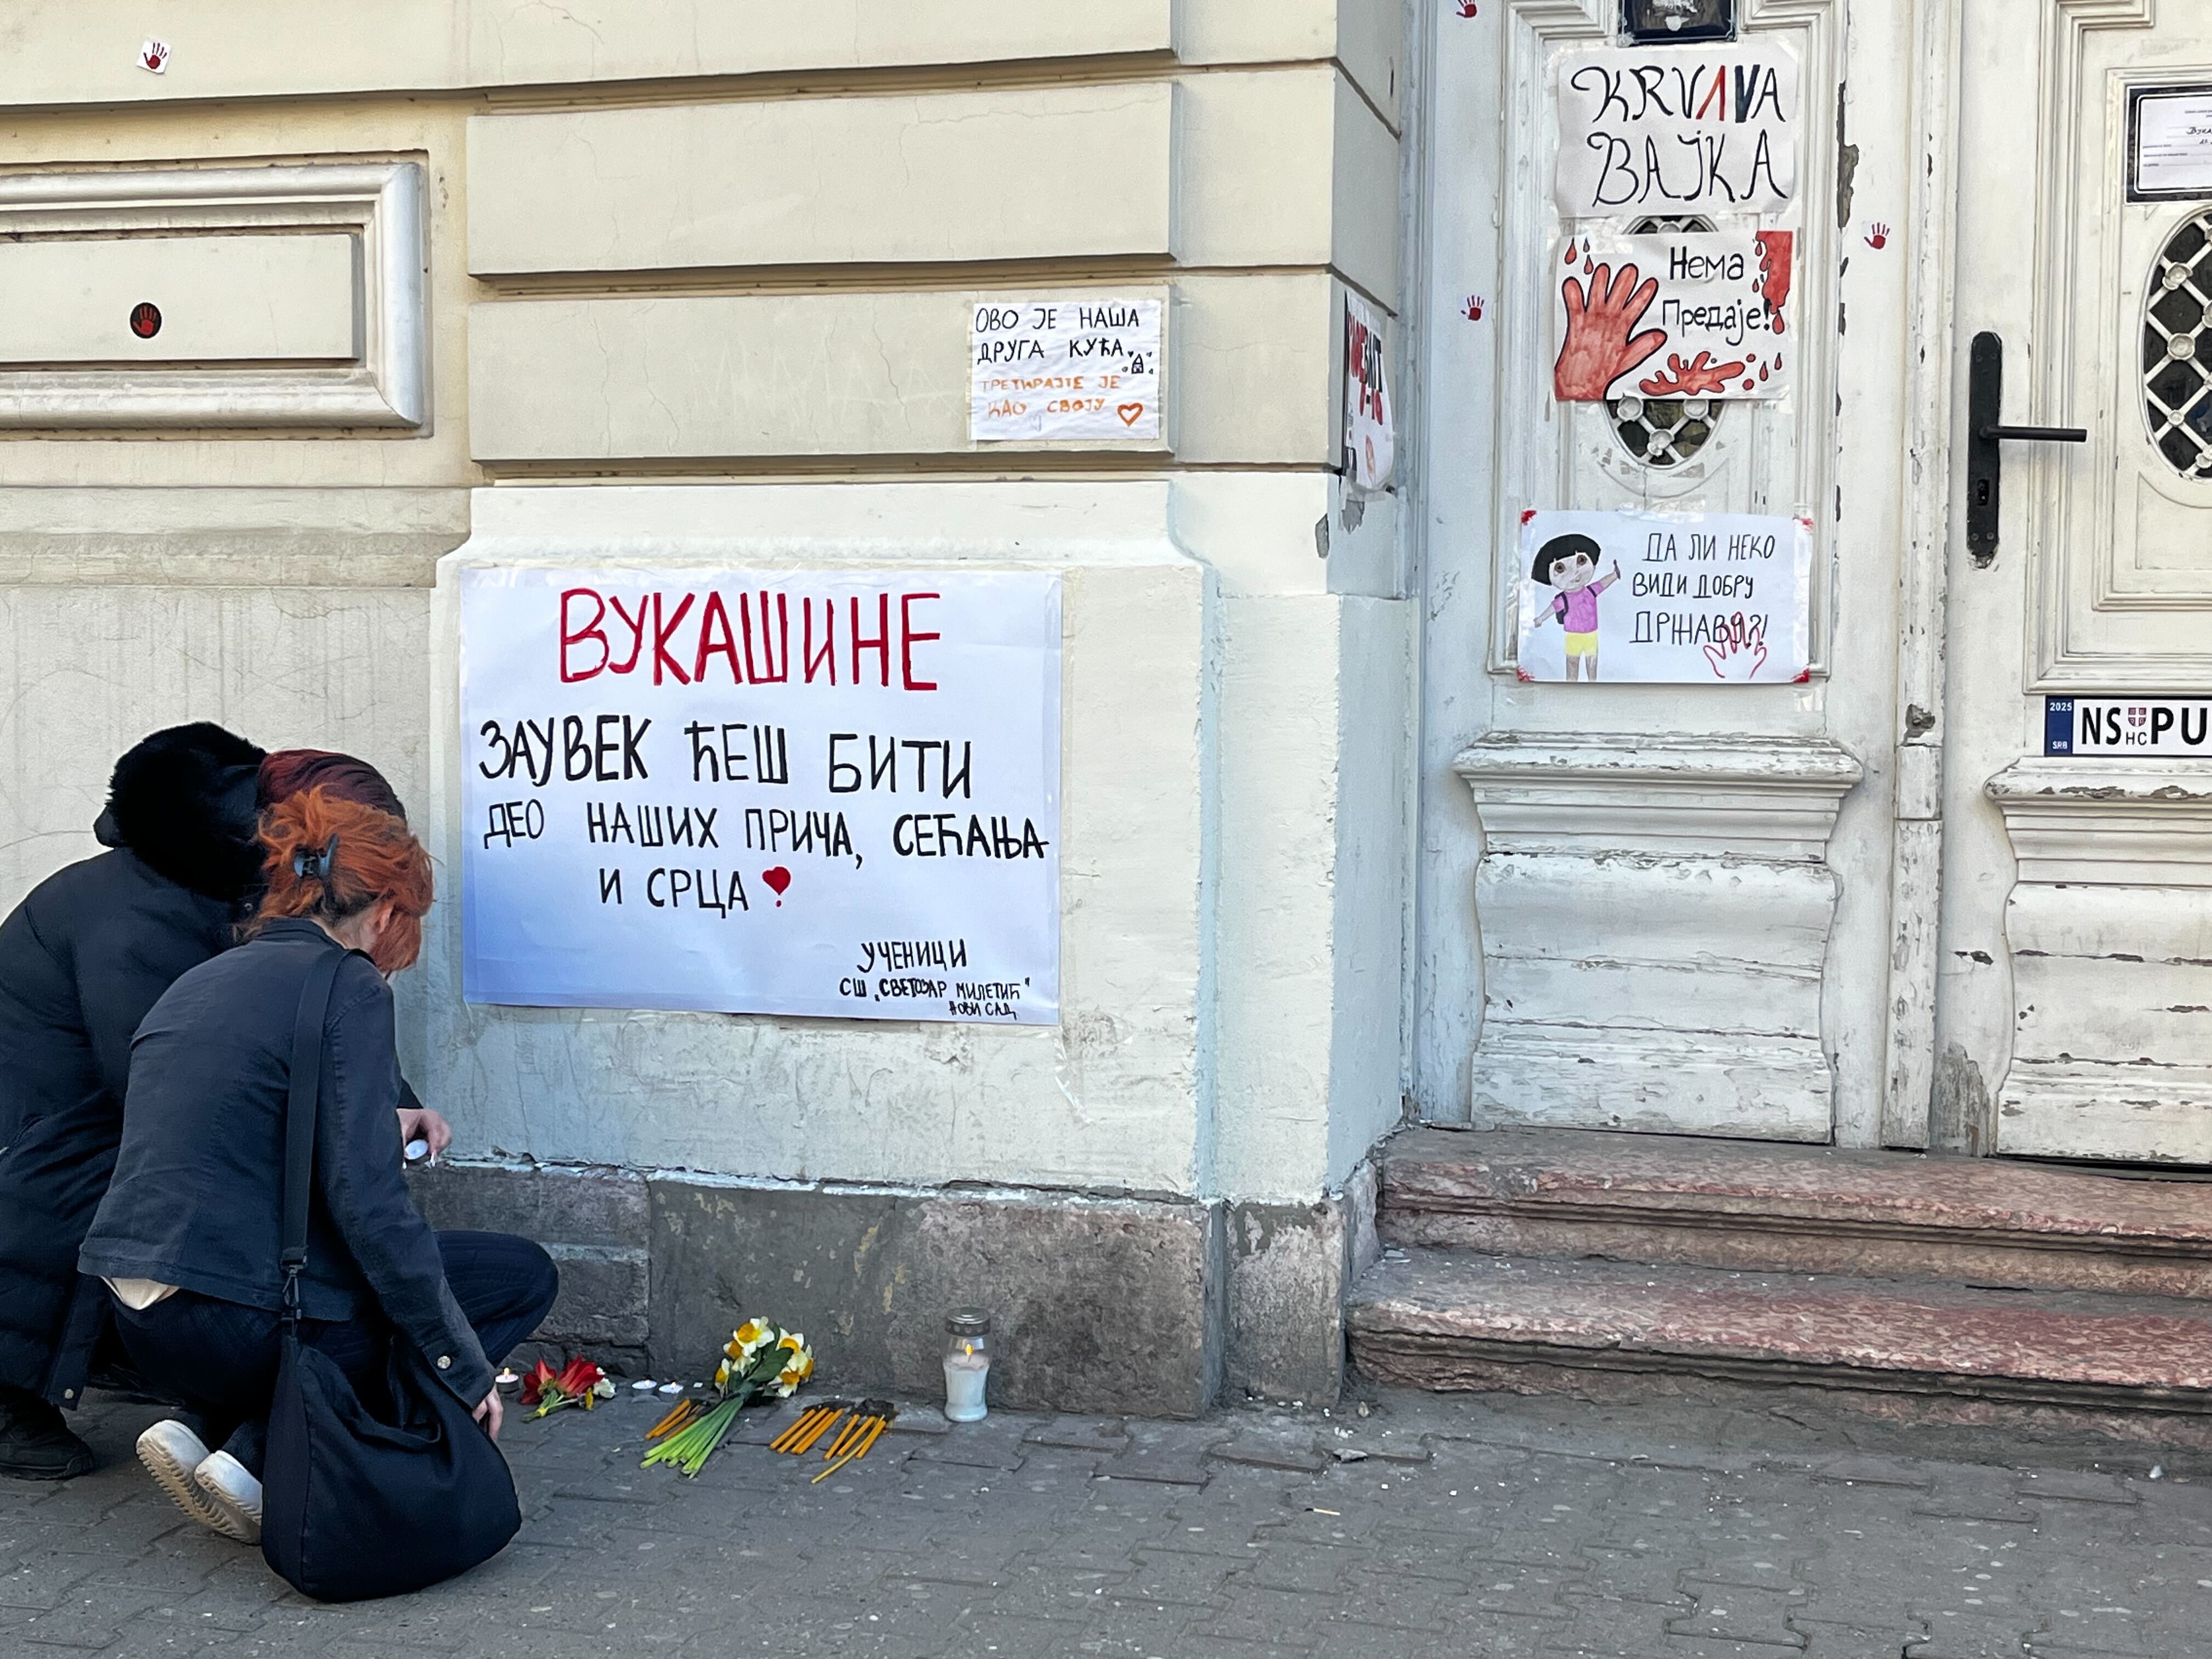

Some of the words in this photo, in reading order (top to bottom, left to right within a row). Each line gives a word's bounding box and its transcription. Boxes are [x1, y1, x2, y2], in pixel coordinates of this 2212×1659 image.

[1587, 129, 1788, 207] BAJKA
[1669, 246, 1744, 280] Нема
[975, 307, 1019, 333] ОВО
[1079, 307, 1139, 329] НАША
[1662, 298, 1770, 346] Предаје!
[977, 339, 1045, 365] ДРУГА
[1069, 337, 1124, 358] КУЋА
[988, 399, 1027, 419] КАО
[1047, 398, 1104, 413] СВОЈУ
[1642, 533, 1677, 562] ДА
[1688, 533, 1716, 561] ЛИ
[1728, 534, 1776, 561] НЕКО
[1632, 572, 1688, 597] ВИДИ
[1692, 574, 1753, 599] ДОБРУ
[560, 588, 940, 691] ВУКАШИНЕ
[2050, 702, 2072, 712] 2025
[2081, 707, 2121, 746] NS
[478, 714, 652, 787] ЗАУВЕК
[684, 720, 788, 785] ЋЕШ
[828, 733, 971, 799] БИТИ
[2052, 741, 2068, 749] SRB
[483, 798, 544, 850] ДЕО
[586, 802, 719, 849] НАШИХ
[745, 808, 863, 868] ПРИЧА,
[893, 813, 1049, 859] СЕЋАЊА
[599, 868, 622, 905] И
[647, 867, 749, 919] СРЦА
[856, 939, 967, 973] УЧЕНИЦИ
[839, 978, 867, 997] СШ
[985, 1002, 1017, 1020] САД
